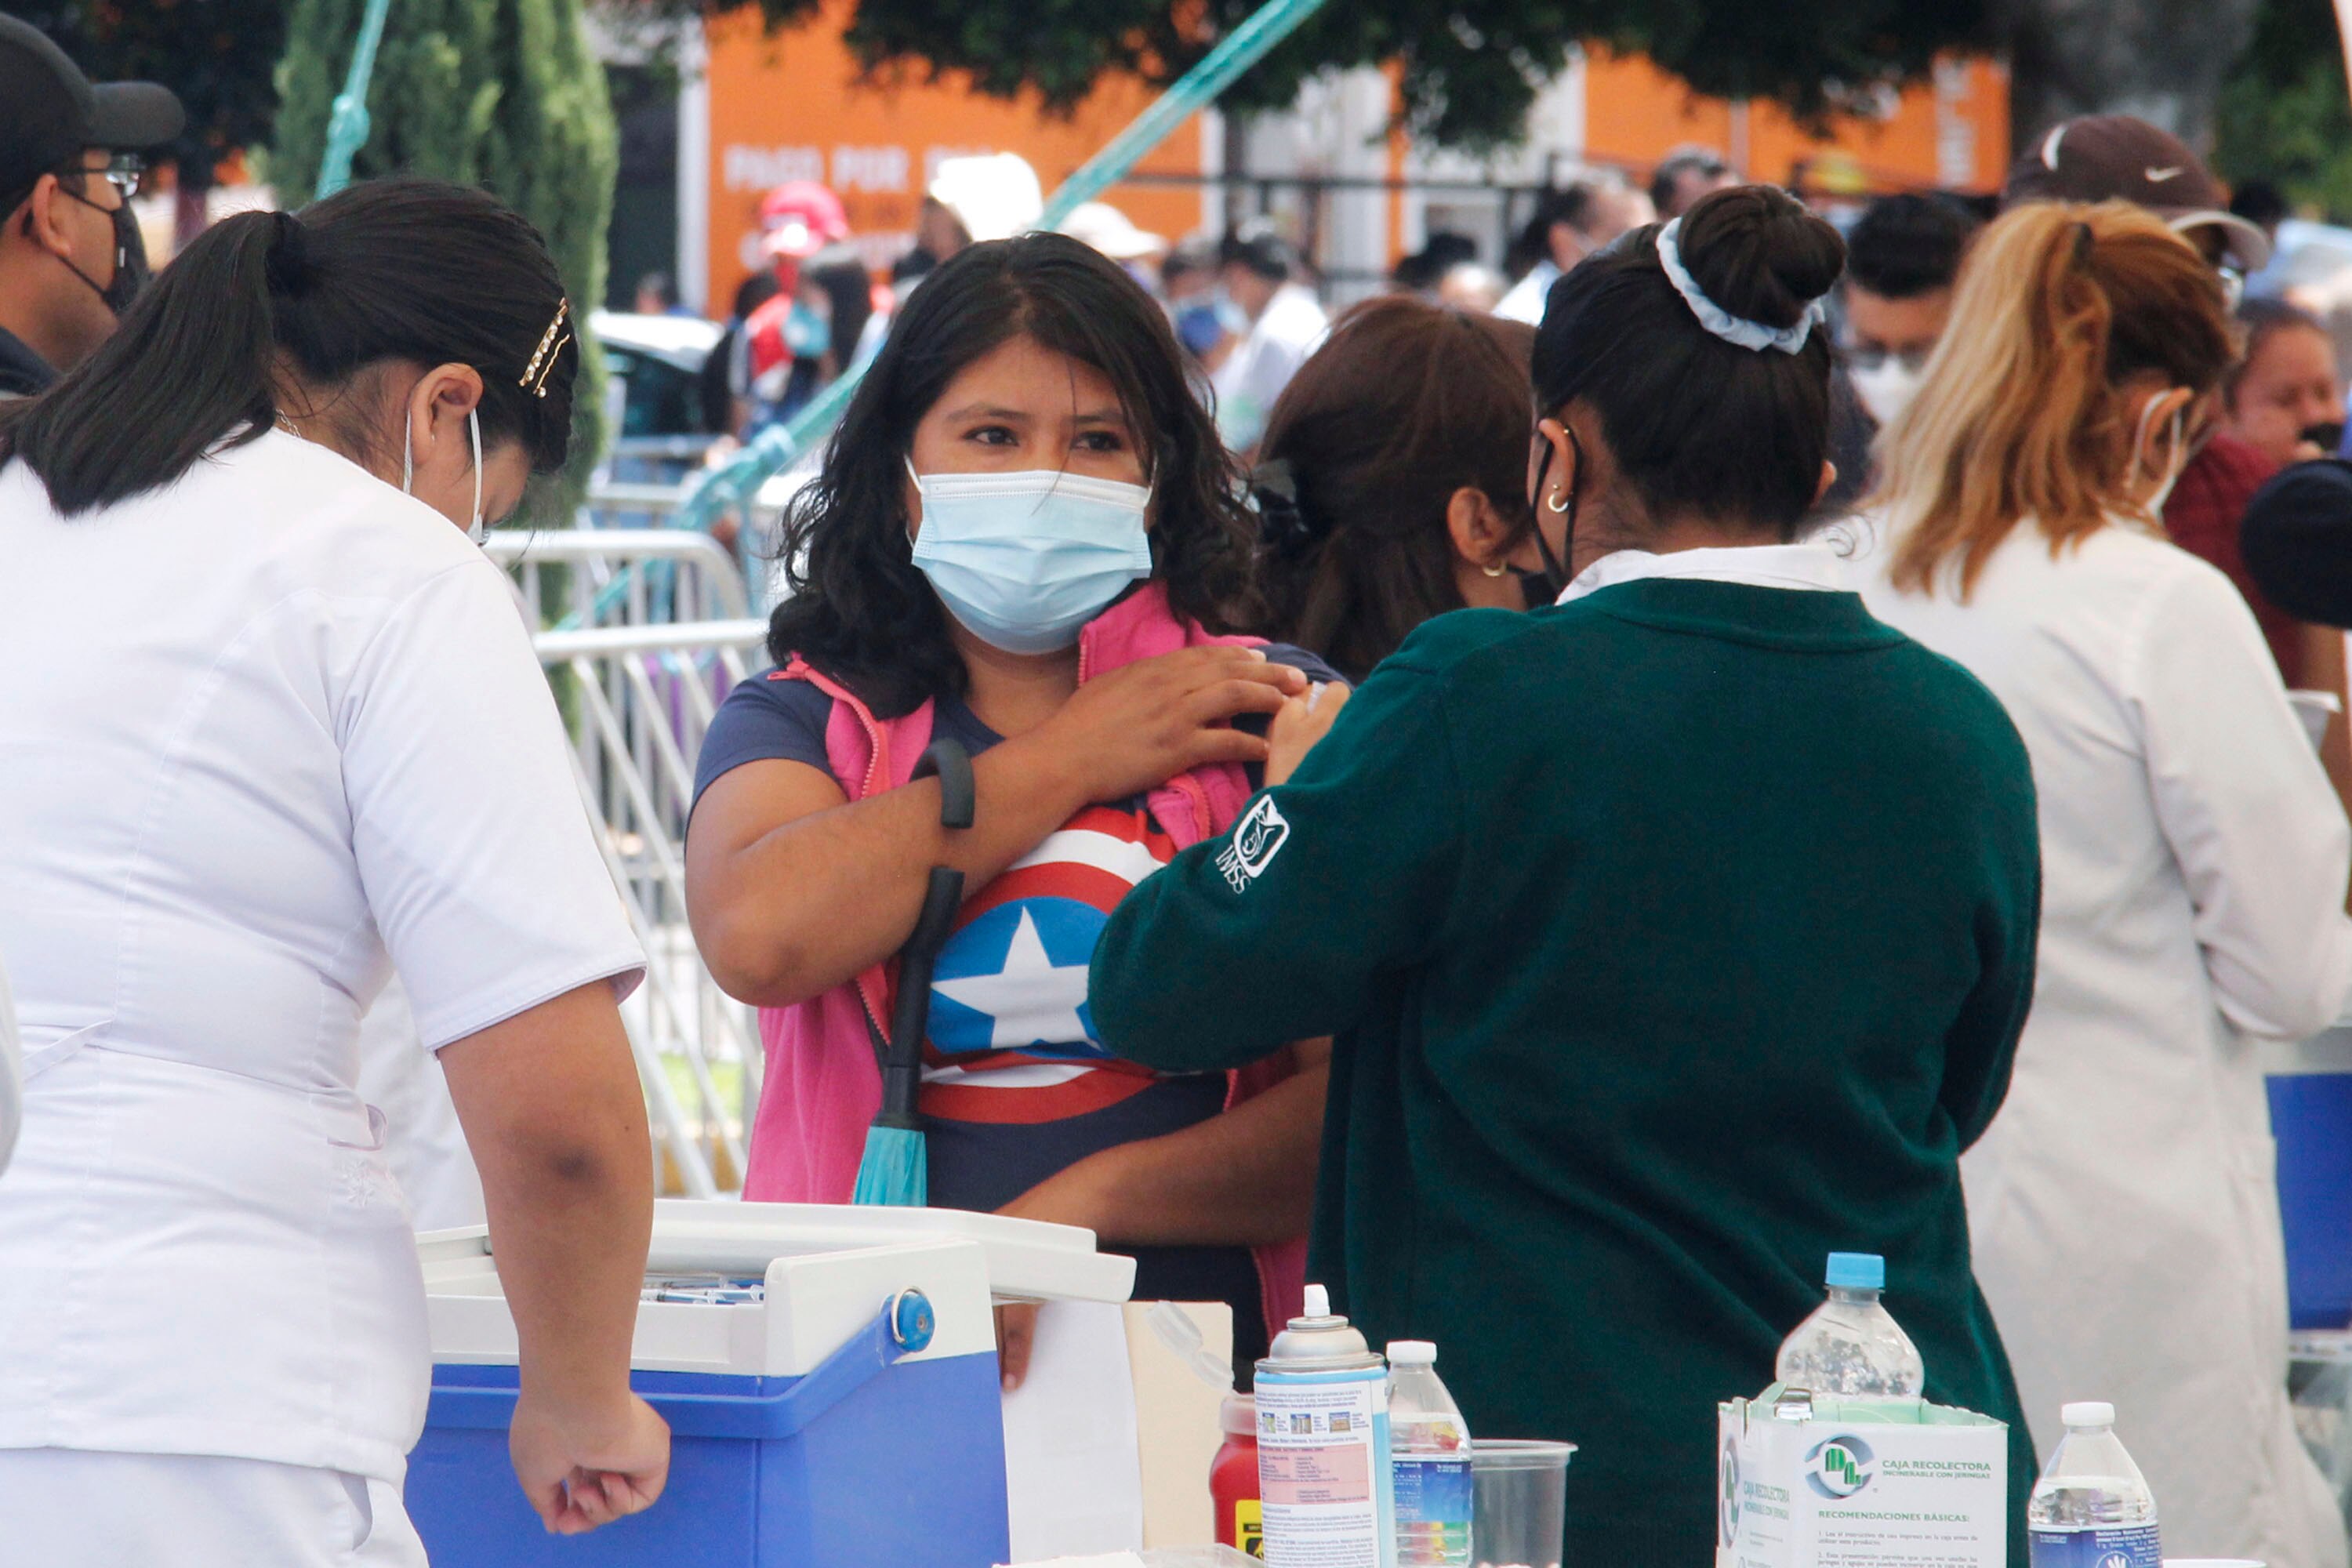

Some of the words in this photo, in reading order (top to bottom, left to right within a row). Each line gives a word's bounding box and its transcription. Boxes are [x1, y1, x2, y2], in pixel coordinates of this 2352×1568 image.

[1214, 844, 1252, 895] IMSS
[1882, 1460, 1910, 1471] CAJA
[1912, 1461, 1992, 1472] RECOLECTORA
[1955, 1472, 1991, 1480] JERINGAS
[1744, 1479, 1755, 1496] CAJA
[1755, 1482, 1790, 1504] RECOLECTORA
[1818, 1510, 1922, 1521] RECOMENDACIONES
[1923, 1512, 1970, 1523] BÁSICAS:
